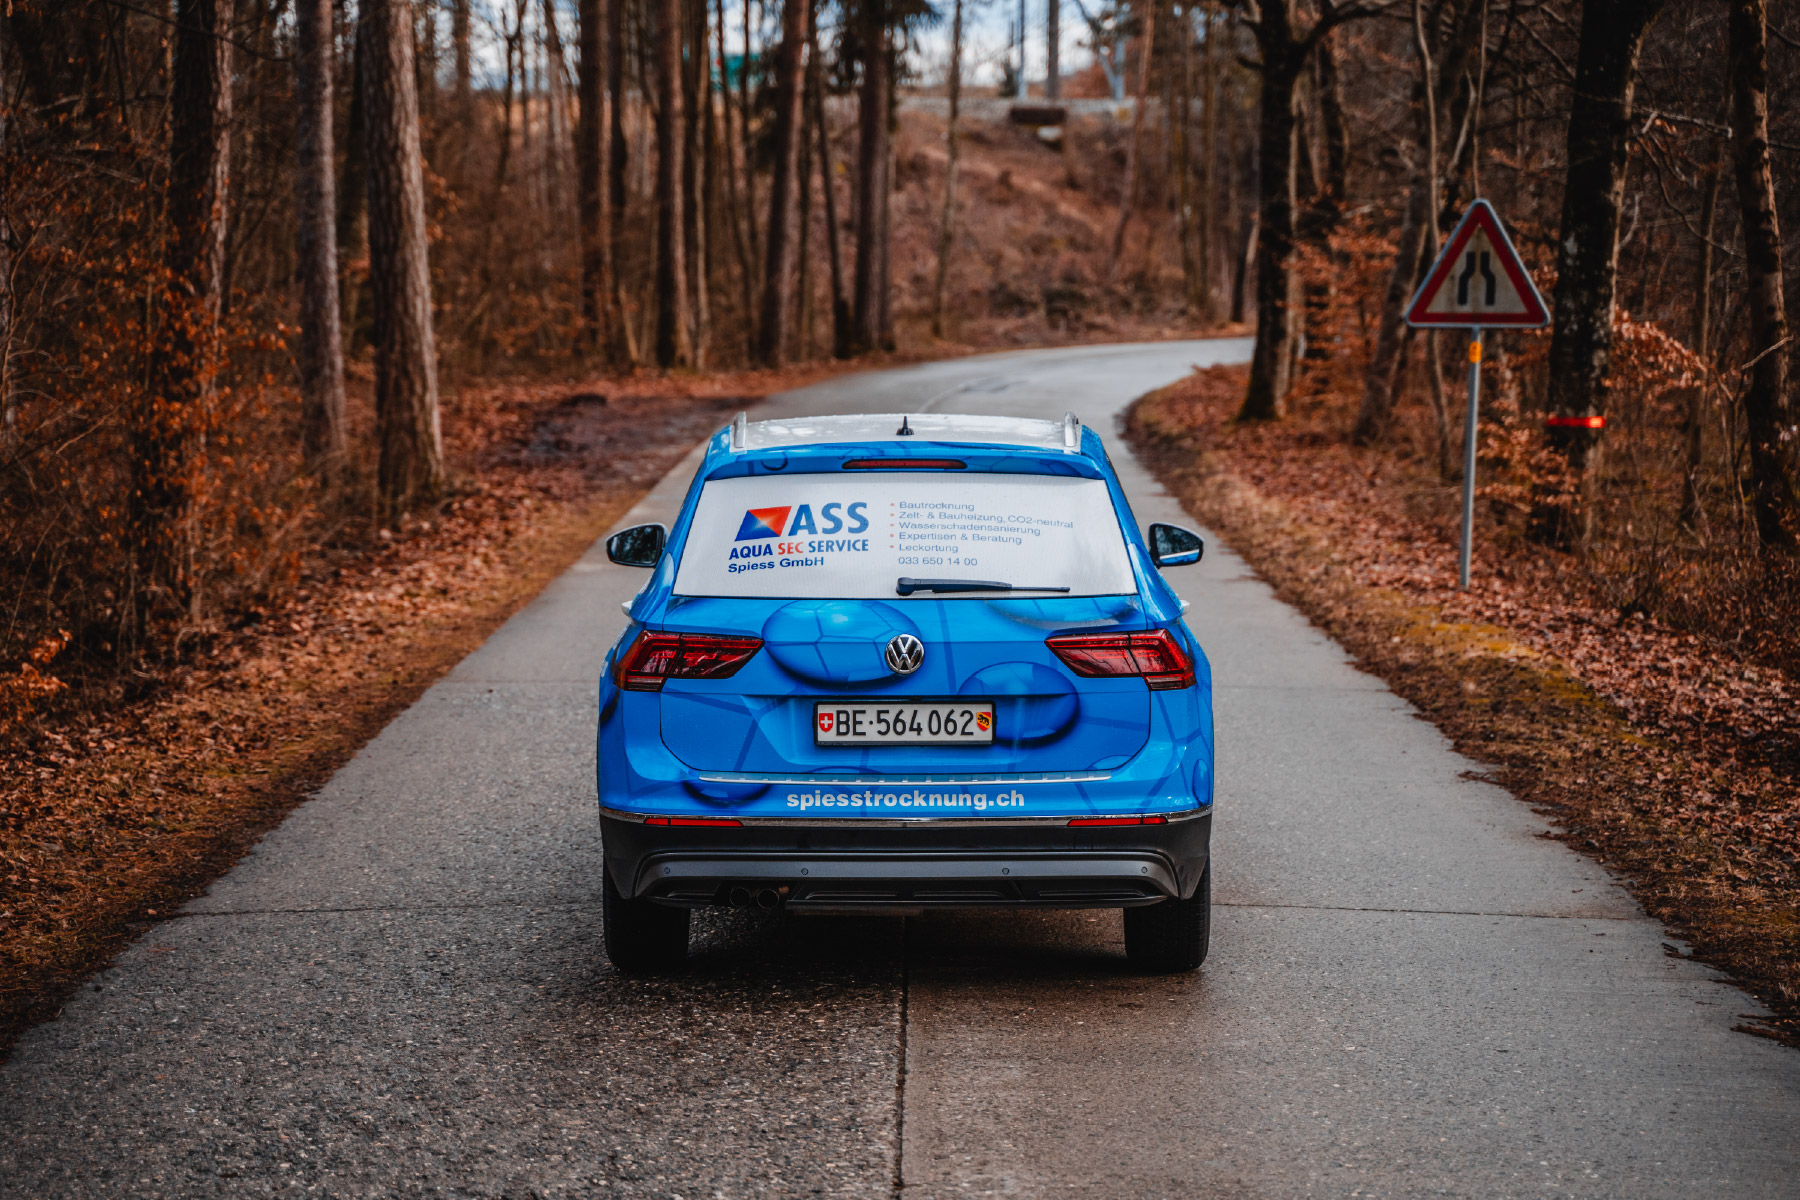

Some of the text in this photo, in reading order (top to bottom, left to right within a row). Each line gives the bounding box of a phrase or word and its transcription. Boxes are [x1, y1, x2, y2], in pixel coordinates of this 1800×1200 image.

[899, 501, 975, 512] Bautrocknung
[788, 502, 869, 536] ASS
[1008, 515, 1074, 529] CO2-neutral
[899, 522, 1041, 536] Wasserschadensanierung
[899, 532, 1022, 545] Expertisen & Beratung
[729, 539, 869, 560] AQUA SEC SERVICE
[899, 543, 959, 554] Leckortung
[728, 556, 824, 574] Spiess GmbH
[898, 556, 978, 566] 033 650 14 00
[786, 790, 1025, 811] spiesstrocknung.ch
